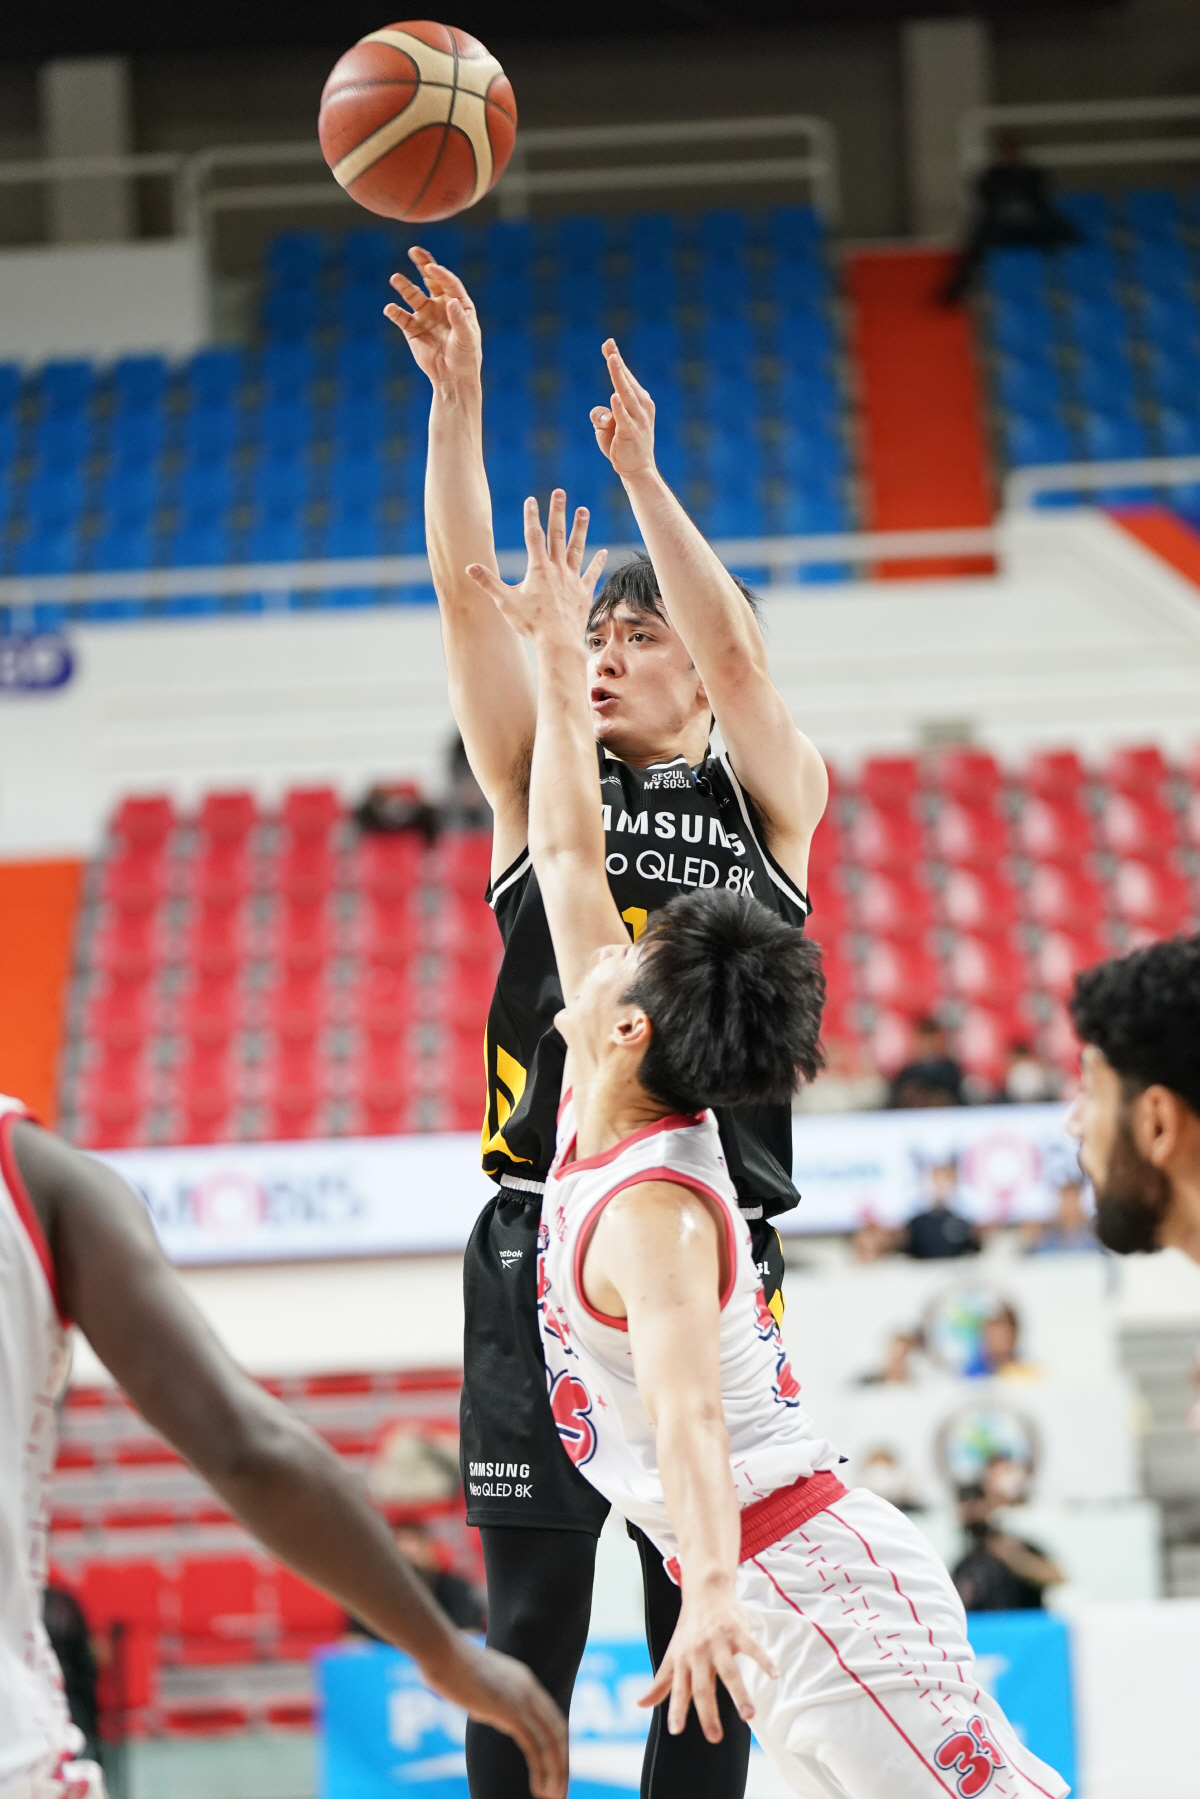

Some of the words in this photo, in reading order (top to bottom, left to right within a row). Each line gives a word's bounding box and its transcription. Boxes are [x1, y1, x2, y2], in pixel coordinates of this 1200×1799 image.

[636, 849, 720, 889] QLED
[725, 865, 754, 898] 8K
[469, 1461, 530, 1479] SAMSUNG
[469, 1481, 482, 1497] Neo
[482, 1482, 512, 1497] QLED
[514, 1483, 533, 1499] 8K
